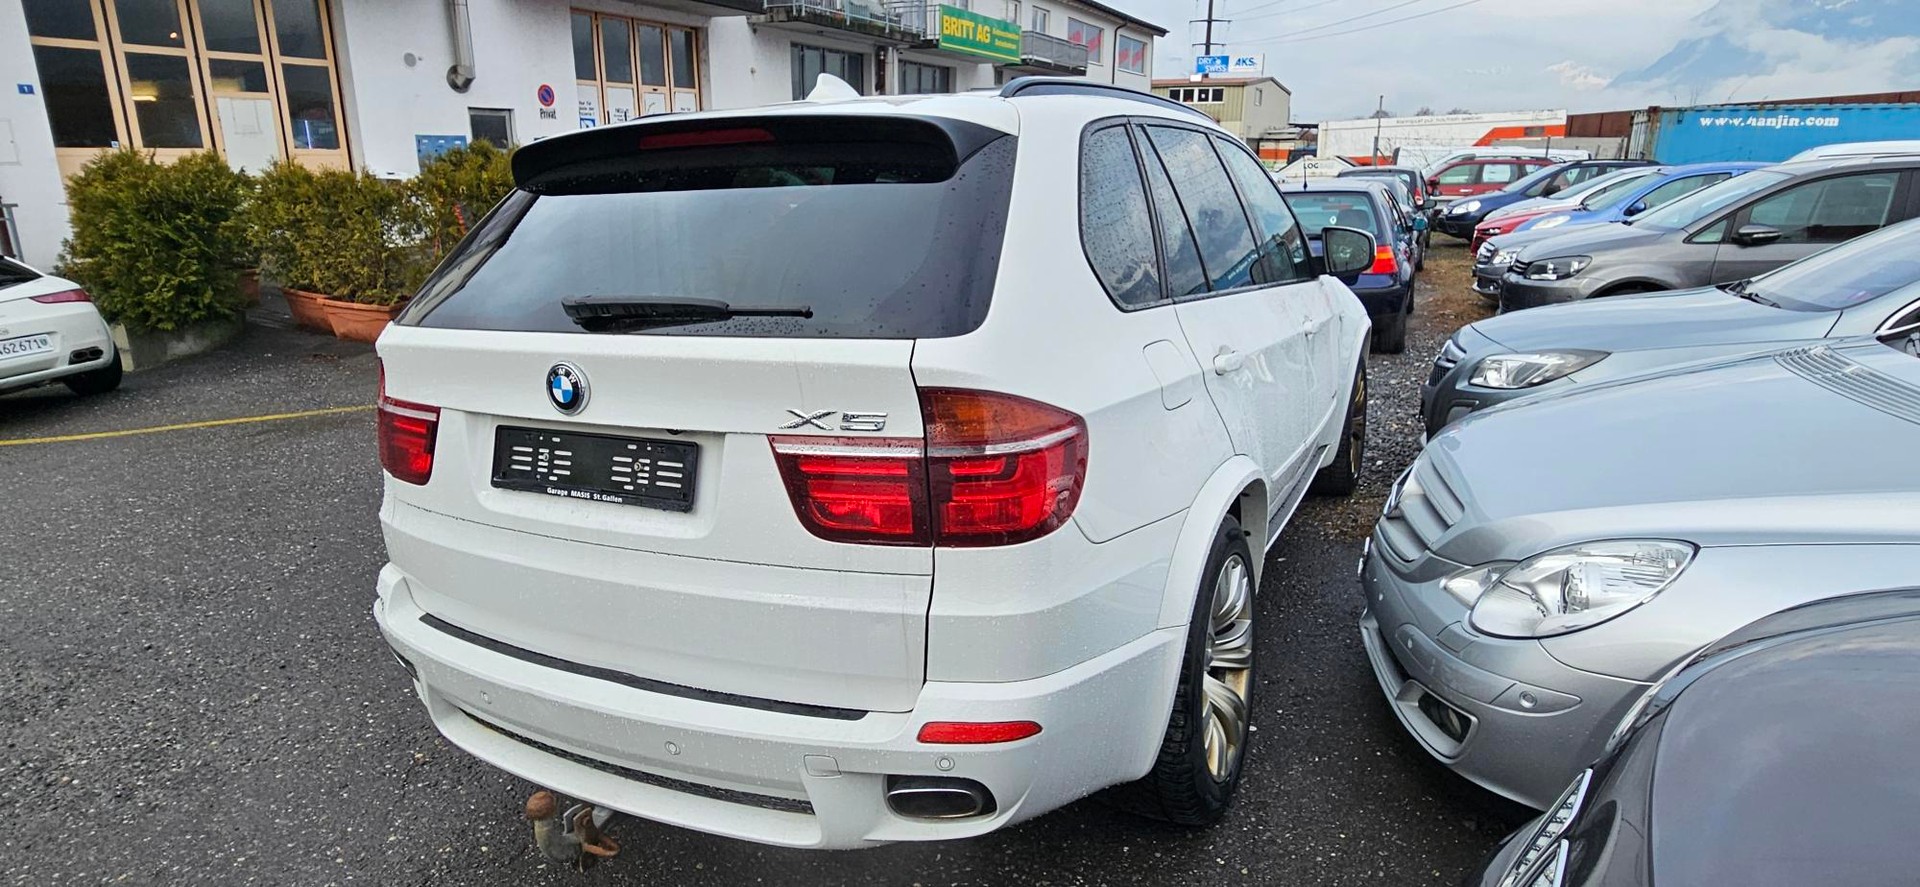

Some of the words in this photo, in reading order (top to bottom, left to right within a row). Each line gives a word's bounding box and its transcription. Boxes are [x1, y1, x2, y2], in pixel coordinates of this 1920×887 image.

[942, 15, 975, 40] BRITT
[976, 24, 991, 43] AG
[1235, 57, 1257, 66] AKS
[539, 107, 557, 120] Privat
[0, 338, 42, 355] 62671
[550, 367, 577, 383] BMW
[778, 408, 888, 432] X5
[546, 487, 569, 497] Garage
[570, 490, 591, 499] MASIS
